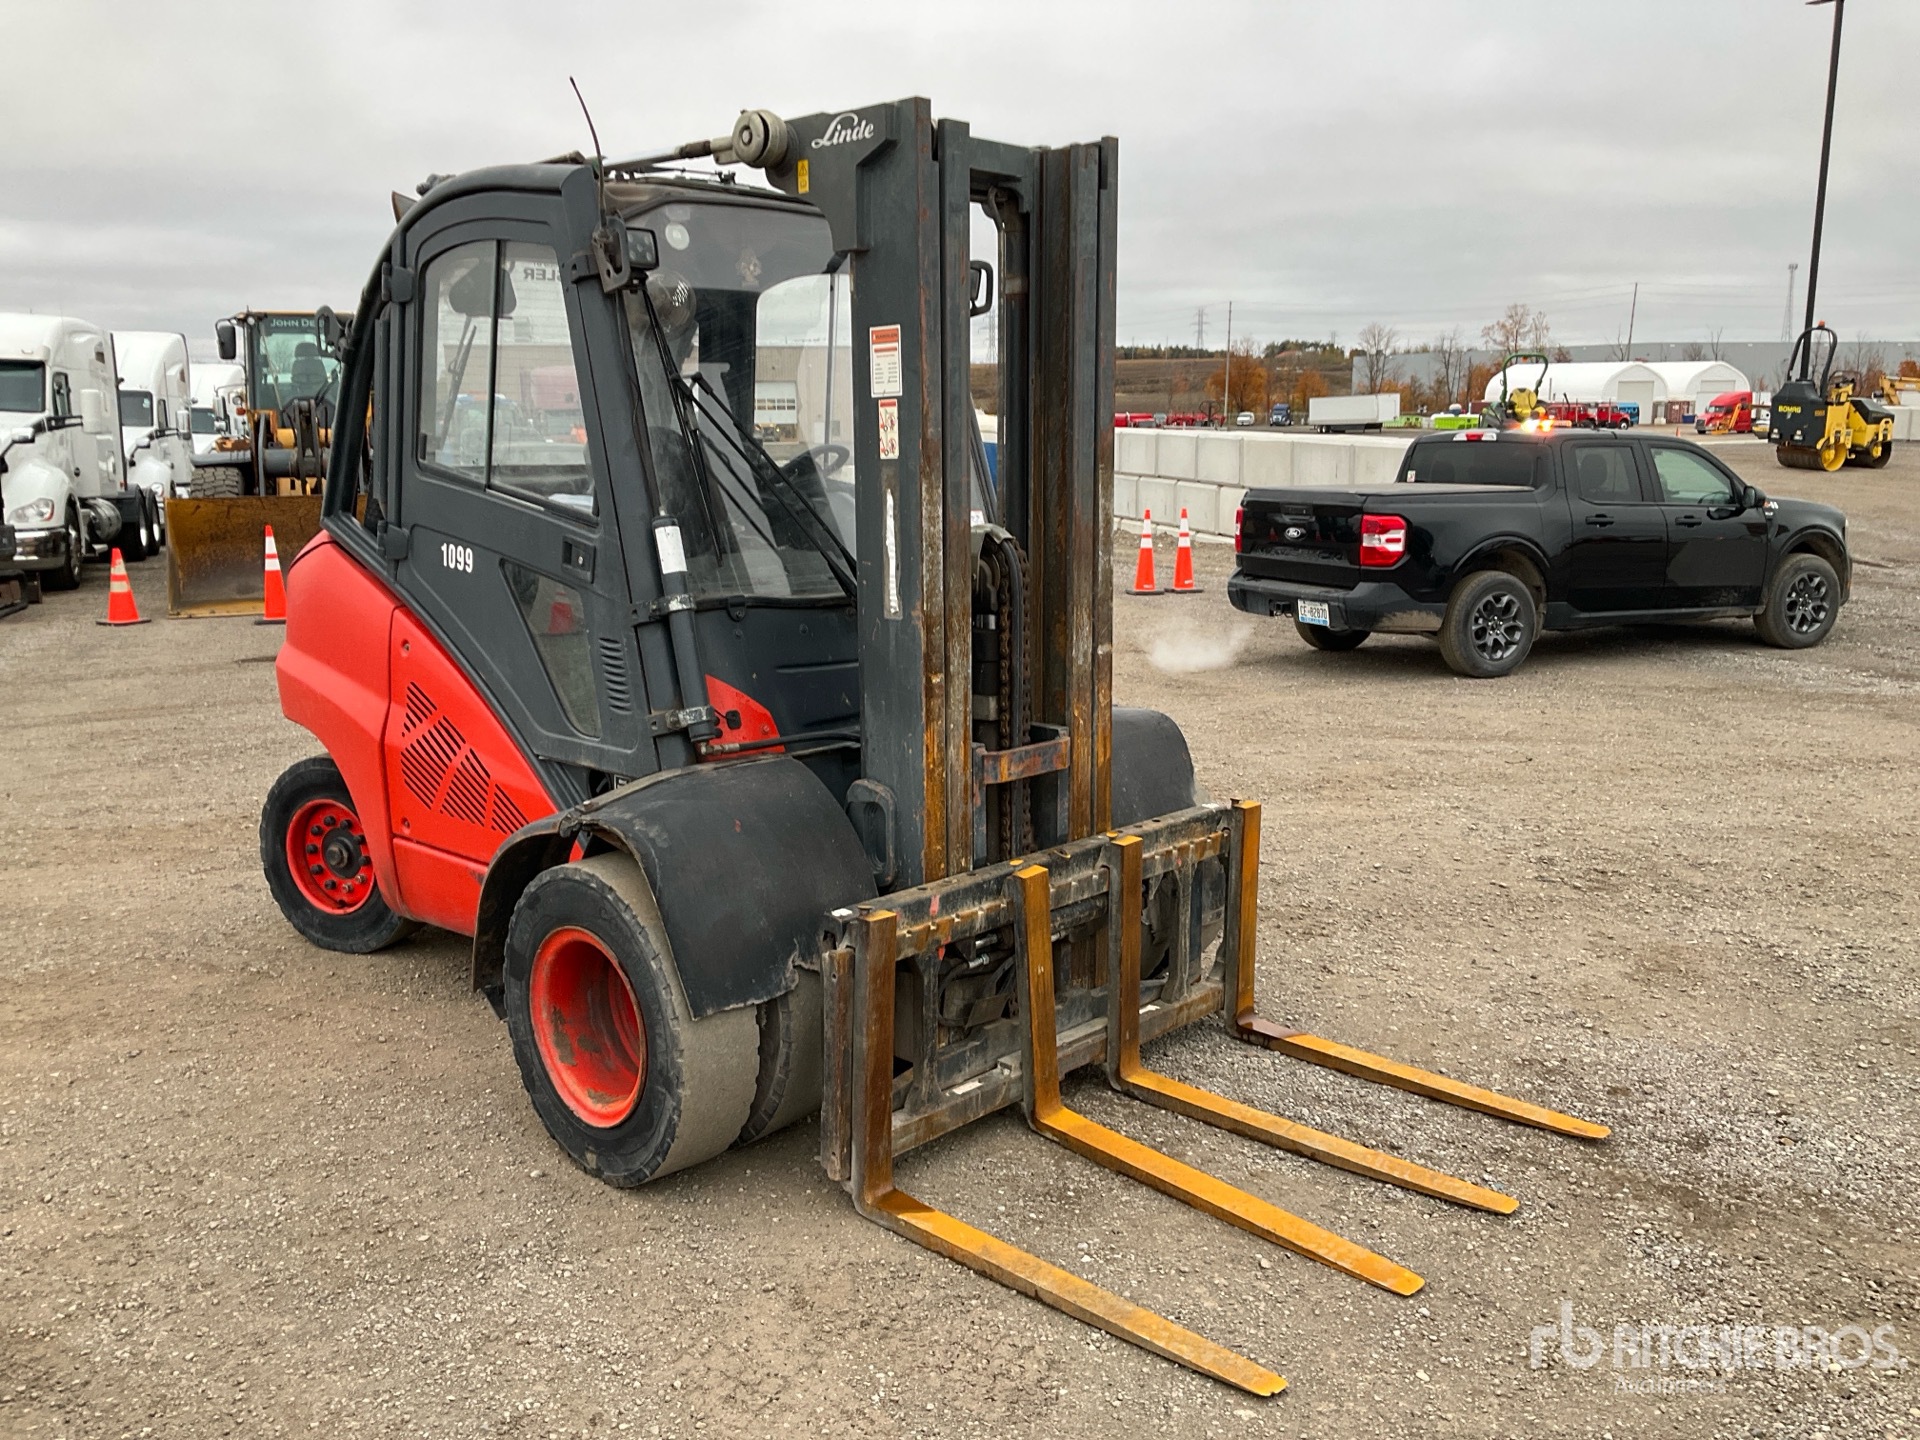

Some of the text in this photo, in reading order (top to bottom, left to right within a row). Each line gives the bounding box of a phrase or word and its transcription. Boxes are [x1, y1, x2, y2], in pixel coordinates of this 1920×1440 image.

[811, 112, 874, 149] Linde
[270, 319, 299, 328] JOHN
[441, 542, 473, 574] 1099
